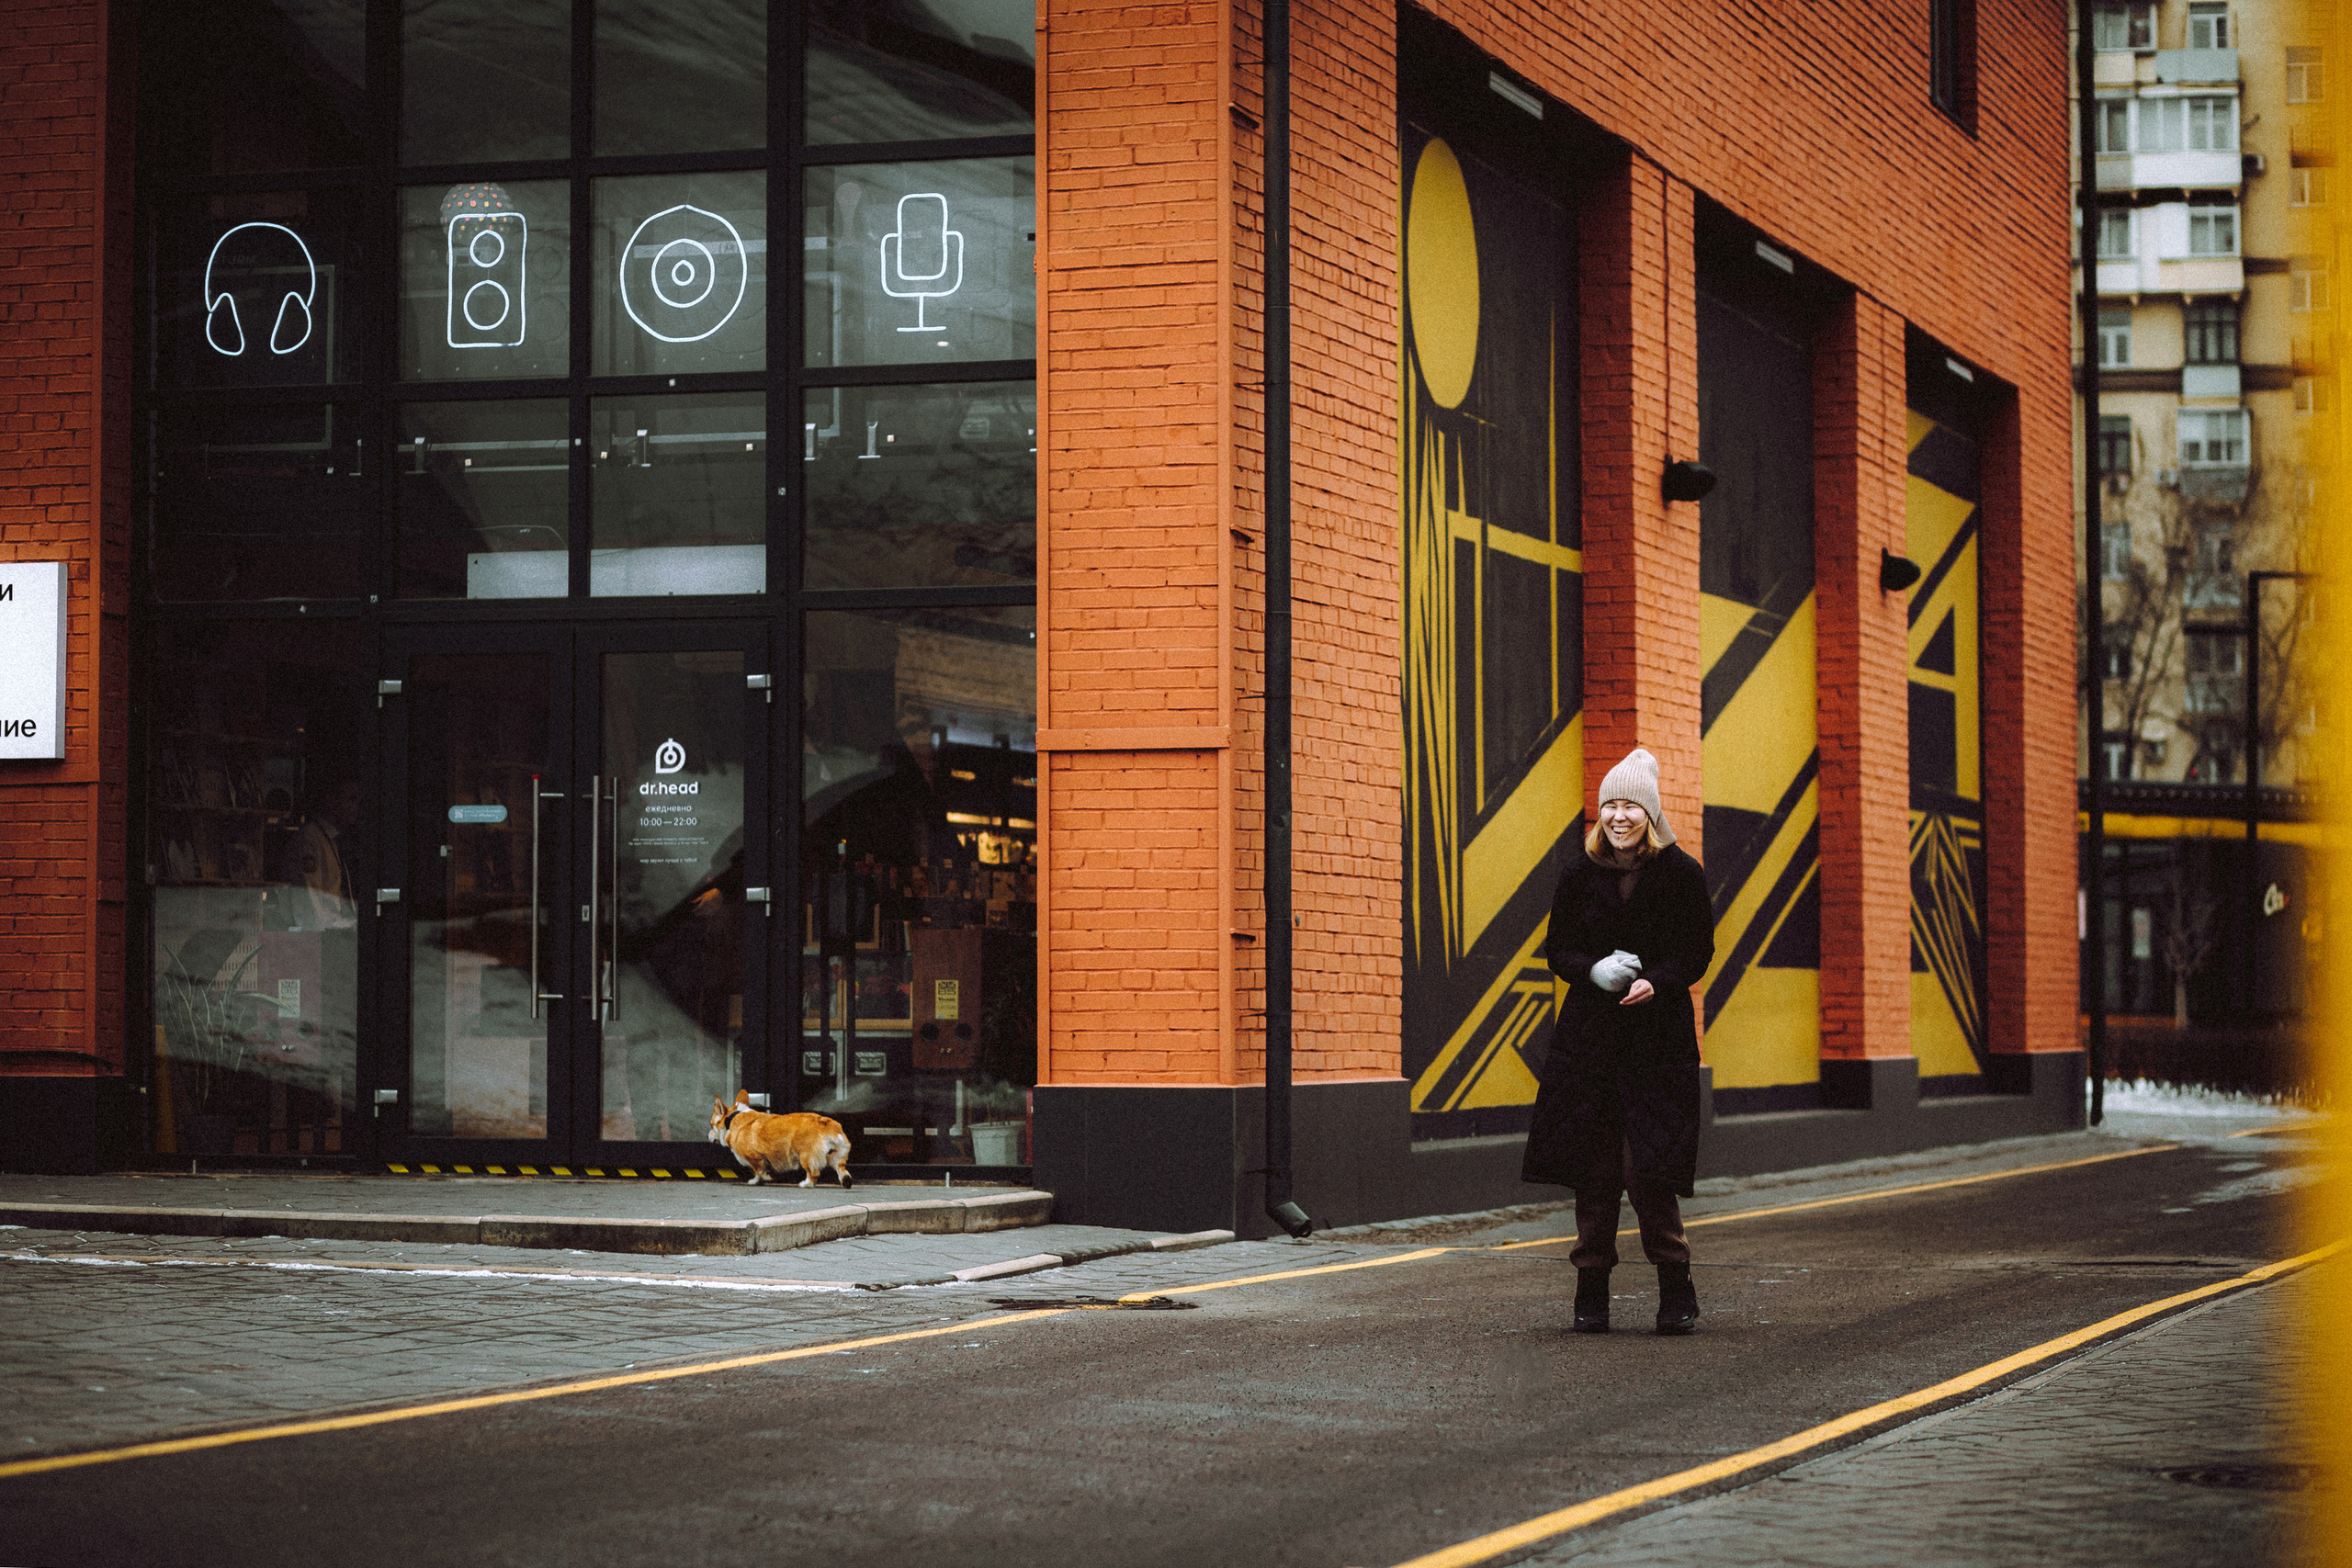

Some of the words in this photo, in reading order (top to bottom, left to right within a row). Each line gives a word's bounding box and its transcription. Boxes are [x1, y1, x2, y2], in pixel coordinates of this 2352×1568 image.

[0, 718, 37, 738] ие
[639, 782, 698, 795] dr.head
[645, 805, 692, 814] ежедневно
[640, 818, 662, 827] 10:00
[673, 817, 697, 826] 22:00
